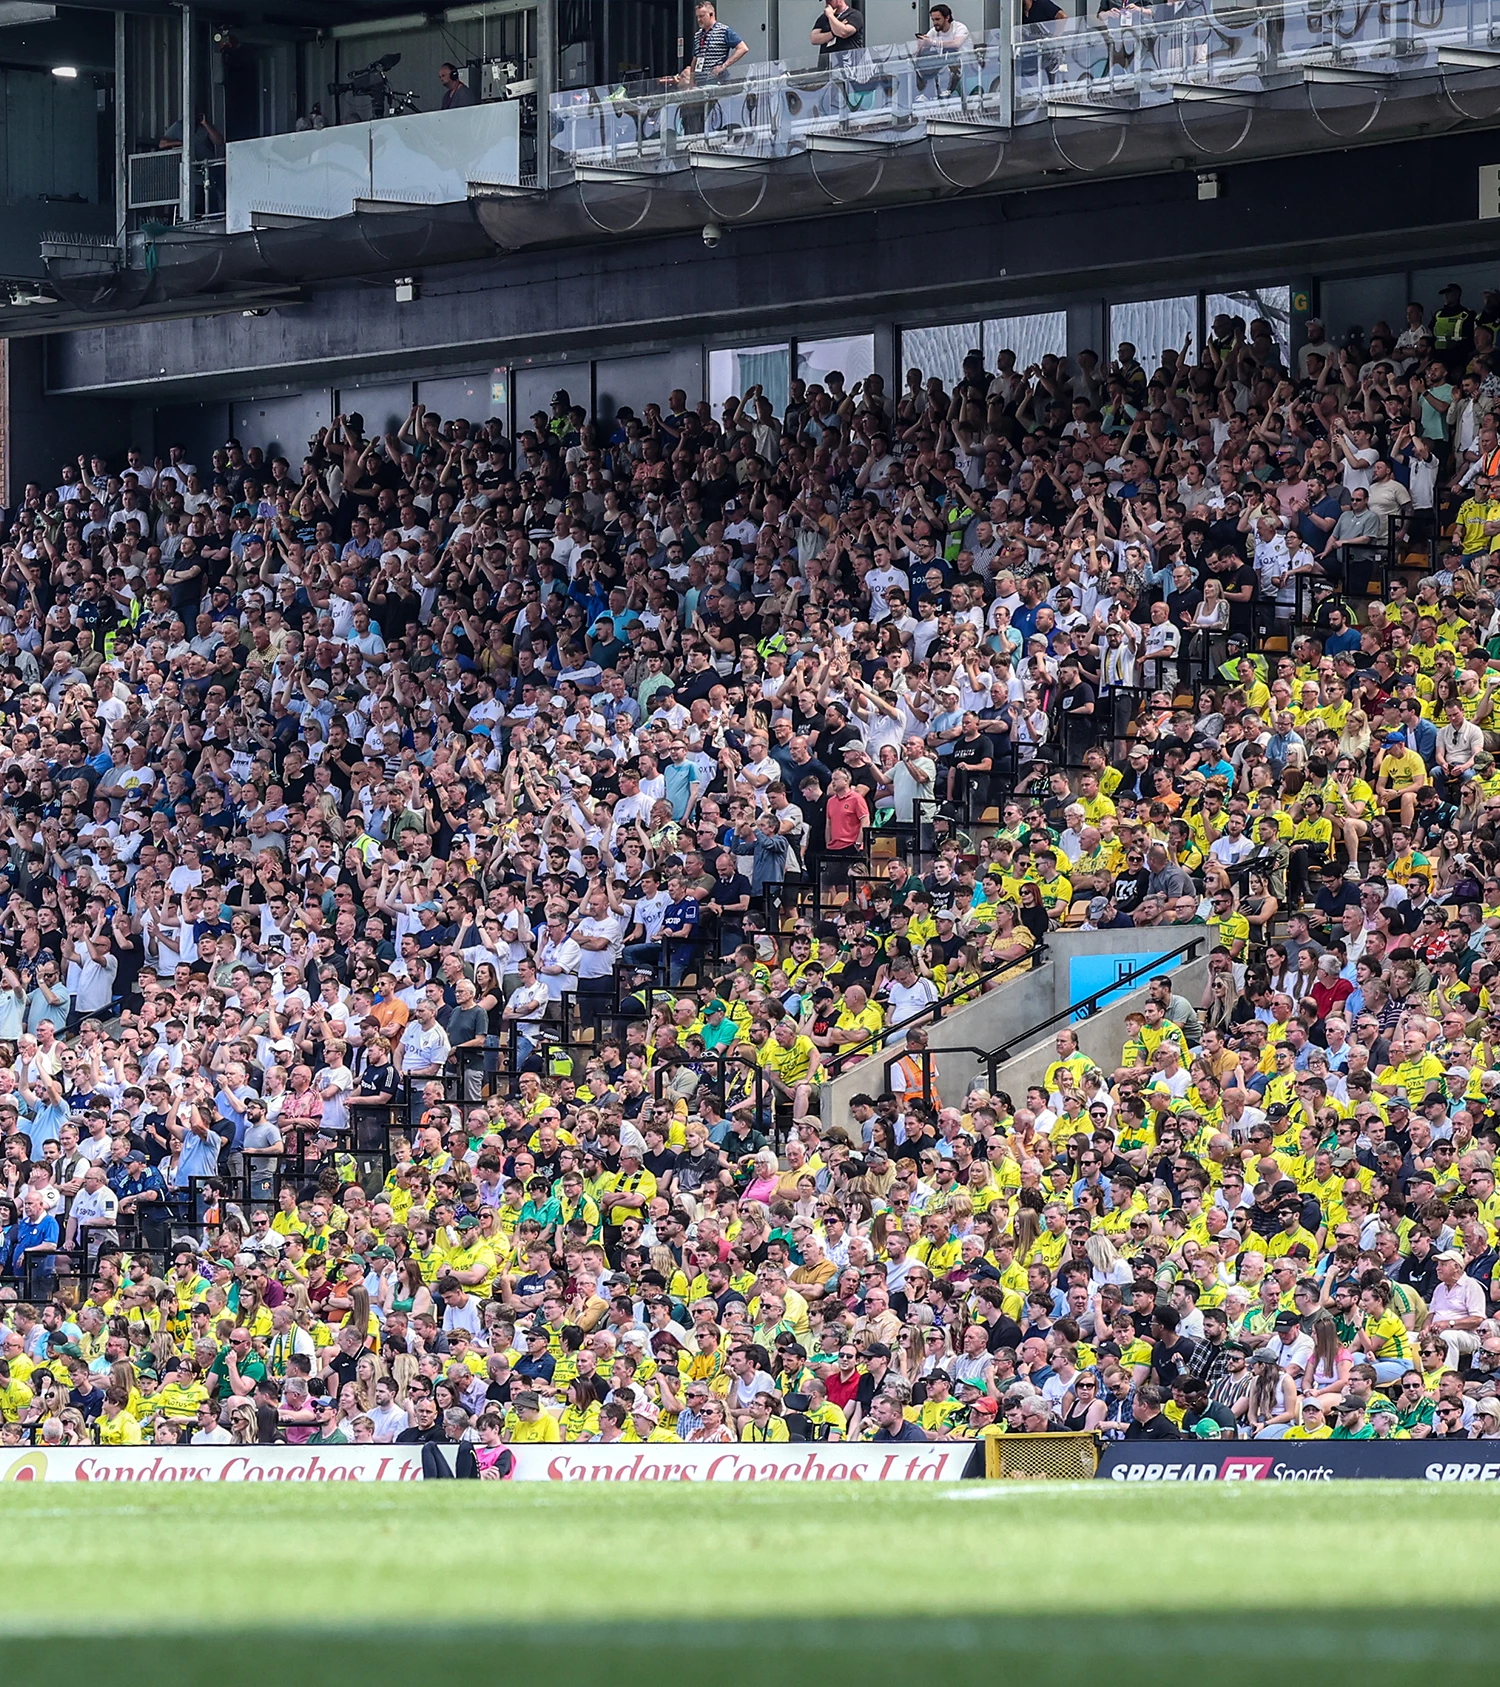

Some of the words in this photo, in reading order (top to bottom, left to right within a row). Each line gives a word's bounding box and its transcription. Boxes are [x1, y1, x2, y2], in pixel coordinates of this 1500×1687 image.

[1294, 293, 1308, 311] G
[1118, 962, 1131, 986] H
[74, 1457, 211, 1481] Sanders
[220, 1456, 366, 1481] Coaches
[547, 1455, 698, 1481] Sanders
[706, 1453, 869, 1481] Coaches
[878, 1452, 950, 1481] Ltd
[1273, 1462, 1335, 1481] Sports
